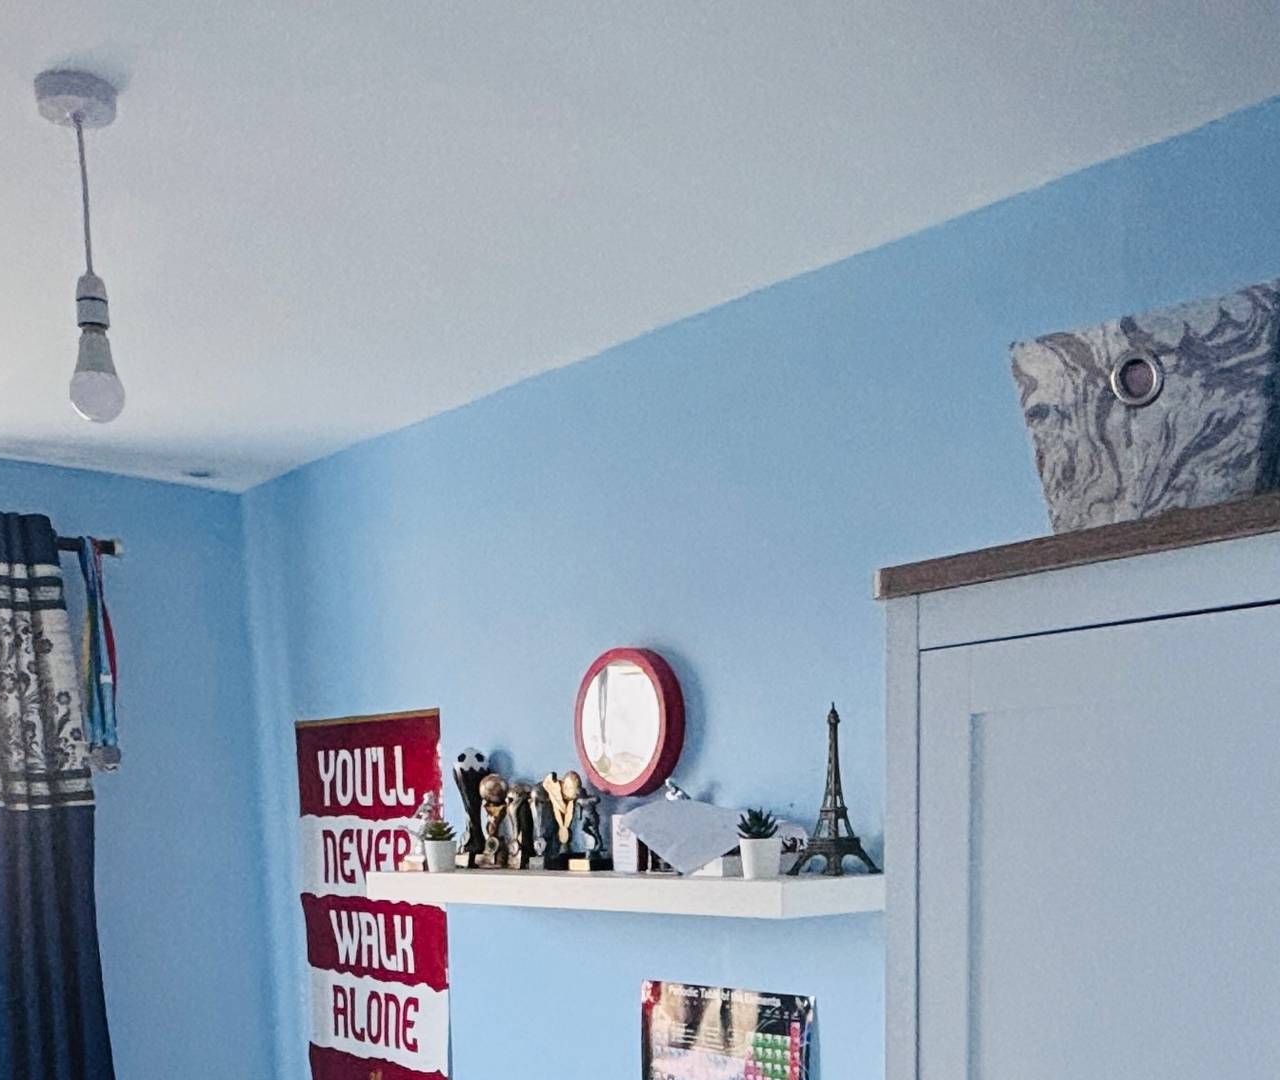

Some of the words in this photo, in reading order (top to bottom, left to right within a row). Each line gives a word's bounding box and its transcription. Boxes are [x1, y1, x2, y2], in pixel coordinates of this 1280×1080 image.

[317, 745, 415, 806] YOU'LL
[329, 909, 415, 974] WALK
[333, 984, 419, 1053] ALONE
